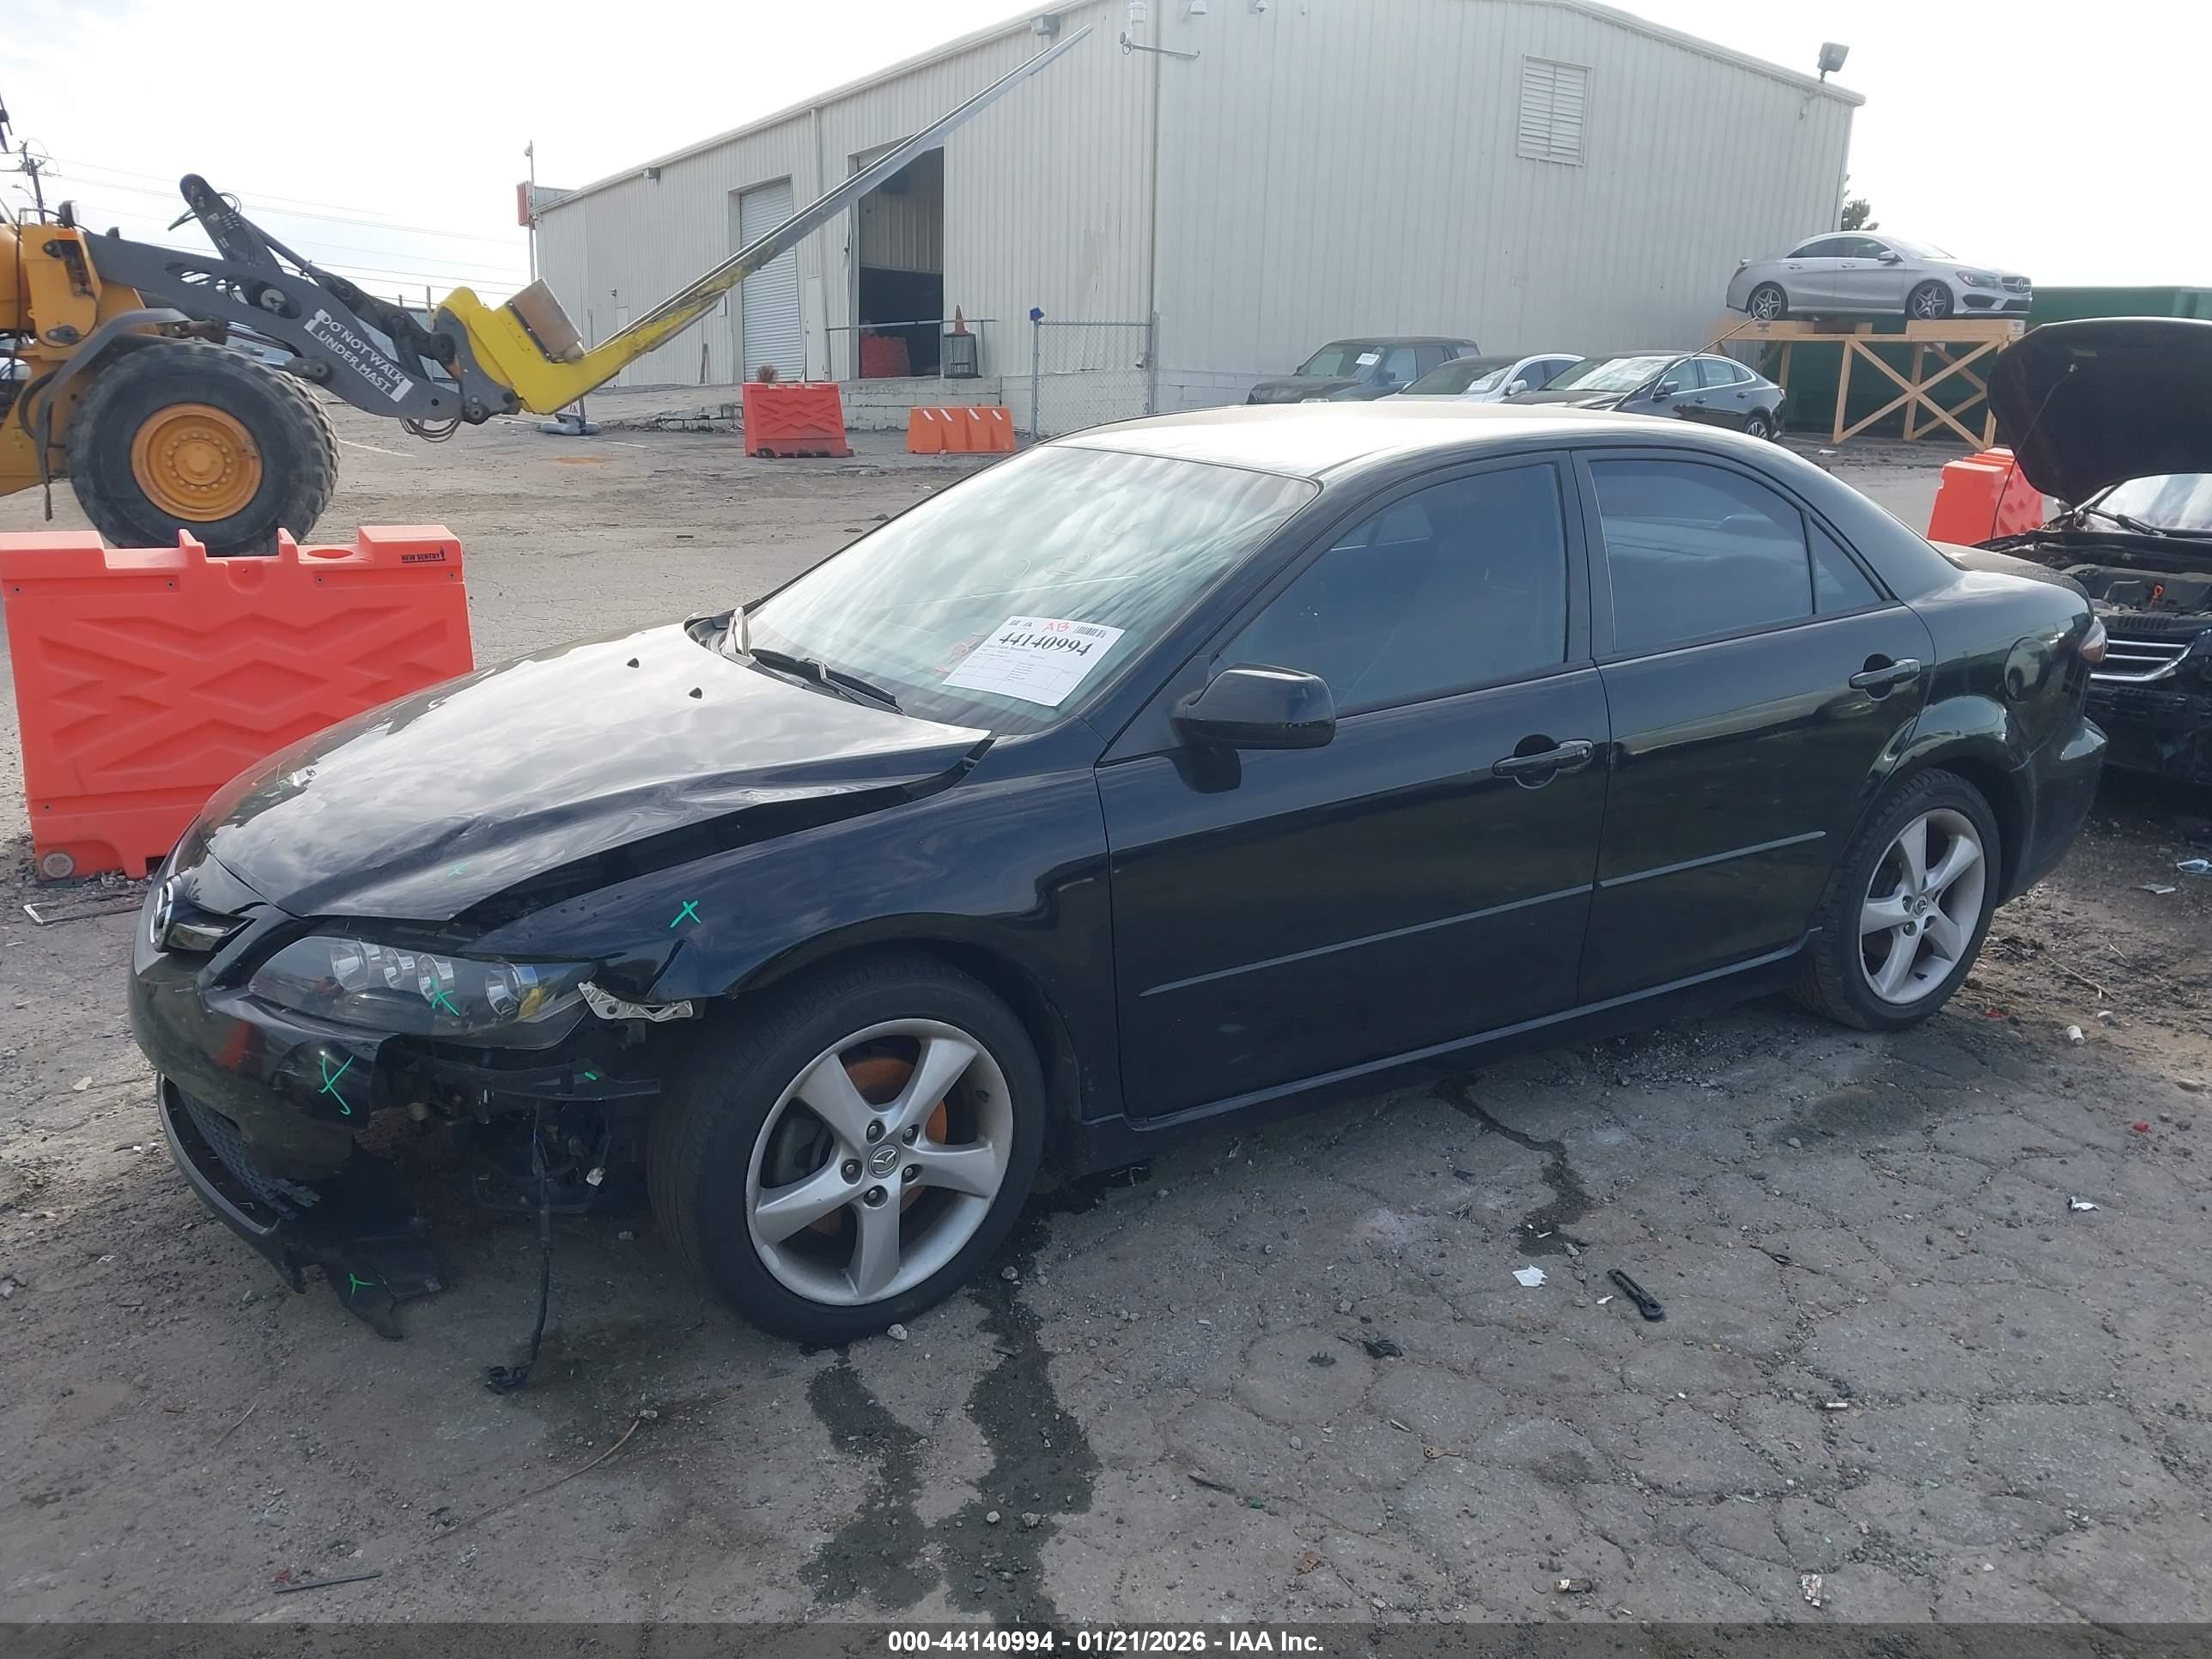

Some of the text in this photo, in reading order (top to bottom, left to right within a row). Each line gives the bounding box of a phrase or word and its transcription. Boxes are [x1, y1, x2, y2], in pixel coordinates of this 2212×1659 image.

[319, 330, 393, 392] UNDER MAST
[321, 314, 406, 384] DO NOT WALK
[999, 631, 1093, 657] 44140994
